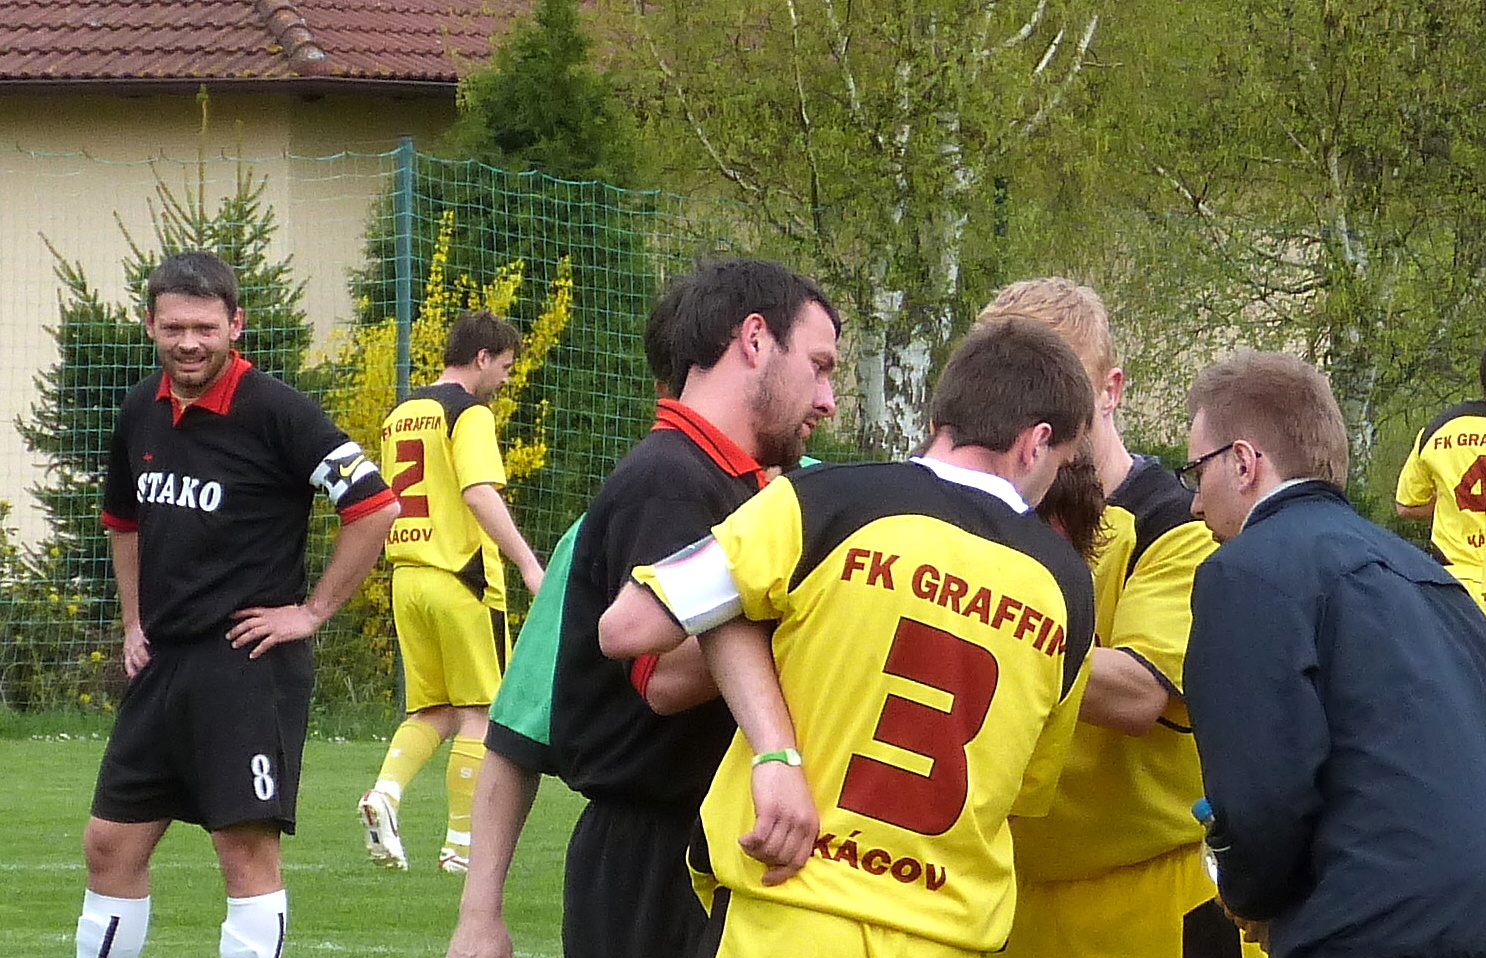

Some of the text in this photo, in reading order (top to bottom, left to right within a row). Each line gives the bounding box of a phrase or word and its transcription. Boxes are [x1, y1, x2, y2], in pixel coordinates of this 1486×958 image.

[1433, 435, 1452, 450] FK
[136, 471, 222, 513] STAKO
[391, 437, 430, 519] 2
[840, 548, 1067, 659] FK GRAFFIN
[836, 615, 1000, 838] 3
[251, 754, 275, 801] 8
